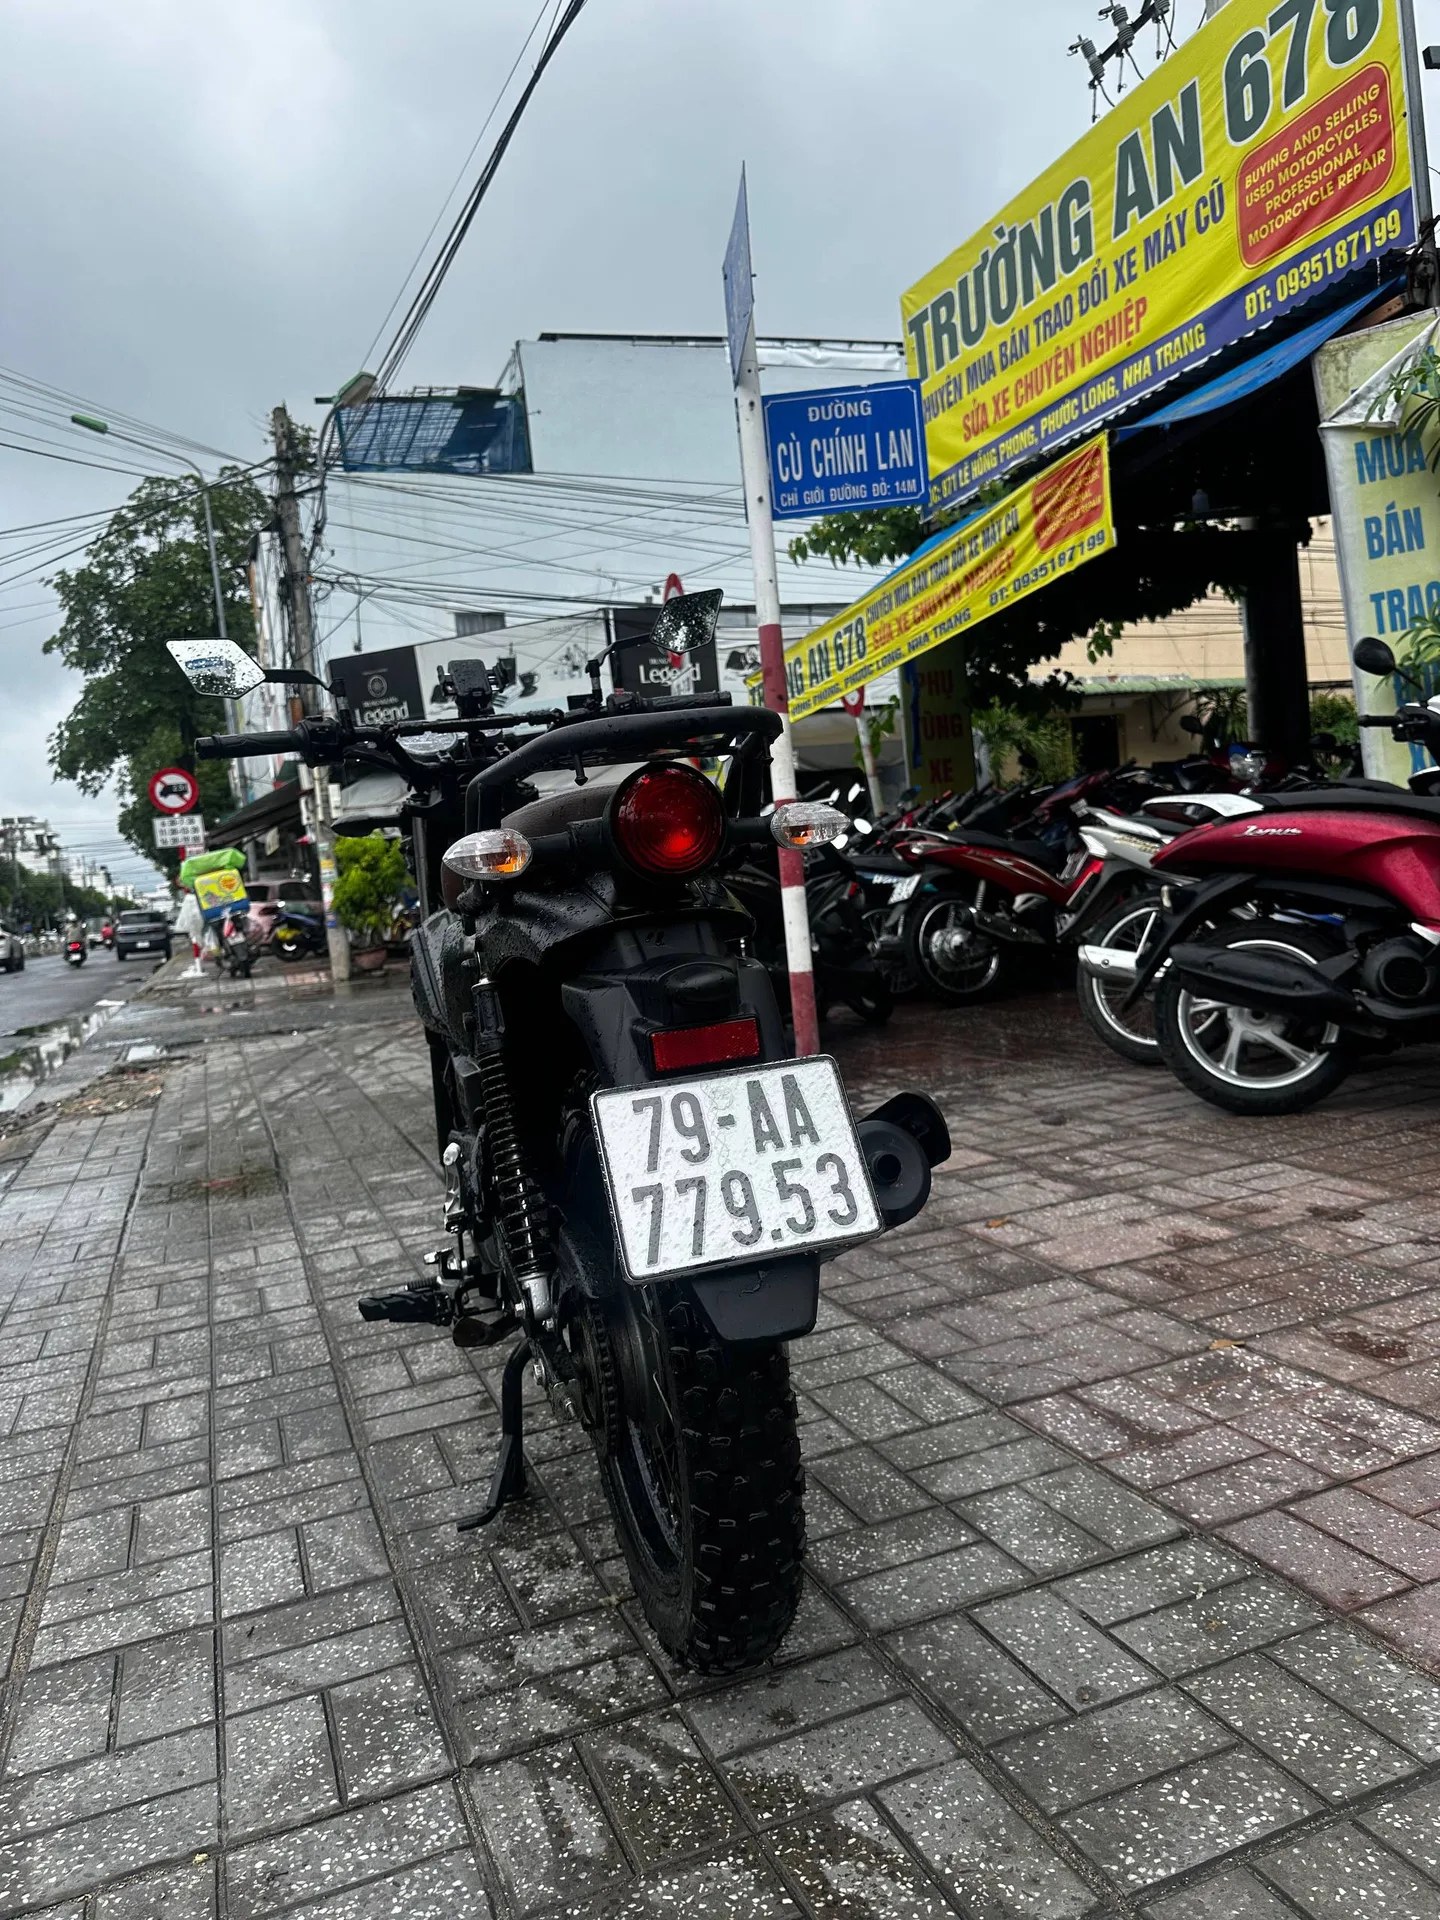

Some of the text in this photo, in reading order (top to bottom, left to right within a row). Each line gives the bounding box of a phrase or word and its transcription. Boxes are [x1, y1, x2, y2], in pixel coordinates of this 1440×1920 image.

[1245, 84, 1381, 189] BUYING AND SELLING
[1245, 108, 1382, 208] USED MOTORCYCLES,
[1265, 143, 1361, 215] PROFESSIONAL
[908, 0, 1382, 384] TRƯỜNG AN 678
[1248, 148, 1386, 247] MOTORCYCLE REPAIR
[923, 176, 1225, 424] HUYÊN MUA BÁN TRAO ĐỔI XE MÁY CŨ
[1245, 208, 1402, 322] ĐT: 0935187199
[808, 399, 872, 422] ĐƯỜNG
[941, 473, 957, 499] 871
[999, 425, 1038, 463] PHONG,
[1041, 397, 1079, 439] PHƯỚC
[1082, 376, 1120, 419] LONG,
[1122, 360, 1152, 390] NHA
[1155, 323, 1206, 372] TRANG
[962, 296, 1147, 442] SỬA XE CHUYÊN NGHIỆP
[777, 427, 914, 483] CÙ CHÍNH LAN
[780, 477, 917, 507] CHỈ GIỚI ĐƯỜNG ĐỎ: 14M
[1354, 428, 1427, 484] MUA
[1012, 529, 1106, 593] 0935187199
[1364, 502, 1425, 560] BÁN
[808, 639, 831, 688] AN
[833, 616, 867, 673] 678
[907, 632, 930, 653] NHA
[933, 608, 972, 638] TRANG
[922, 710, 964, 742] ÙNG
[631, 1073, 821, 1174] 79-AA
[631, 1152, 858, 1268] 779.53
